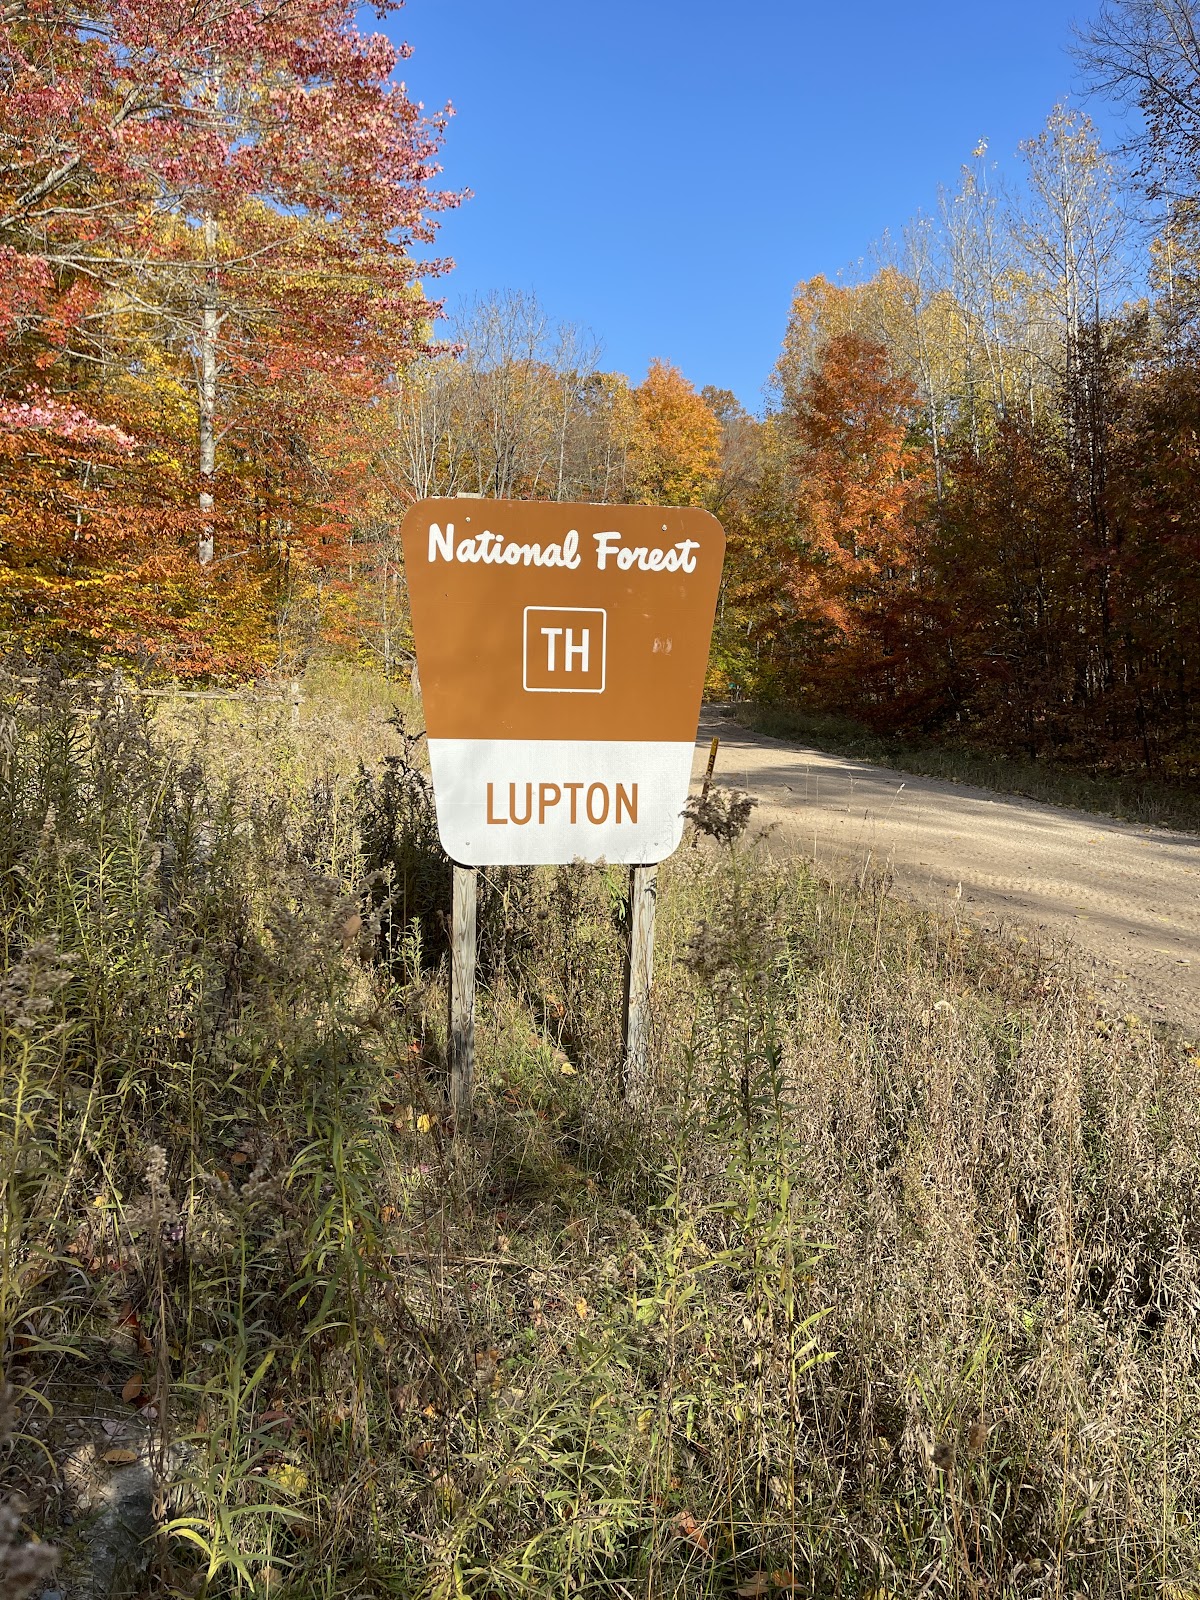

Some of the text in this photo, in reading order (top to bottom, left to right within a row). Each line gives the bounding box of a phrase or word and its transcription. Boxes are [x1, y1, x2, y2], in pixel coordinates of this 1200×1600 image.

[428, 523, 700, 573] National Forest
[540, 627, 590, 672] TH
[486, 782, 639, 826] LUPTON
